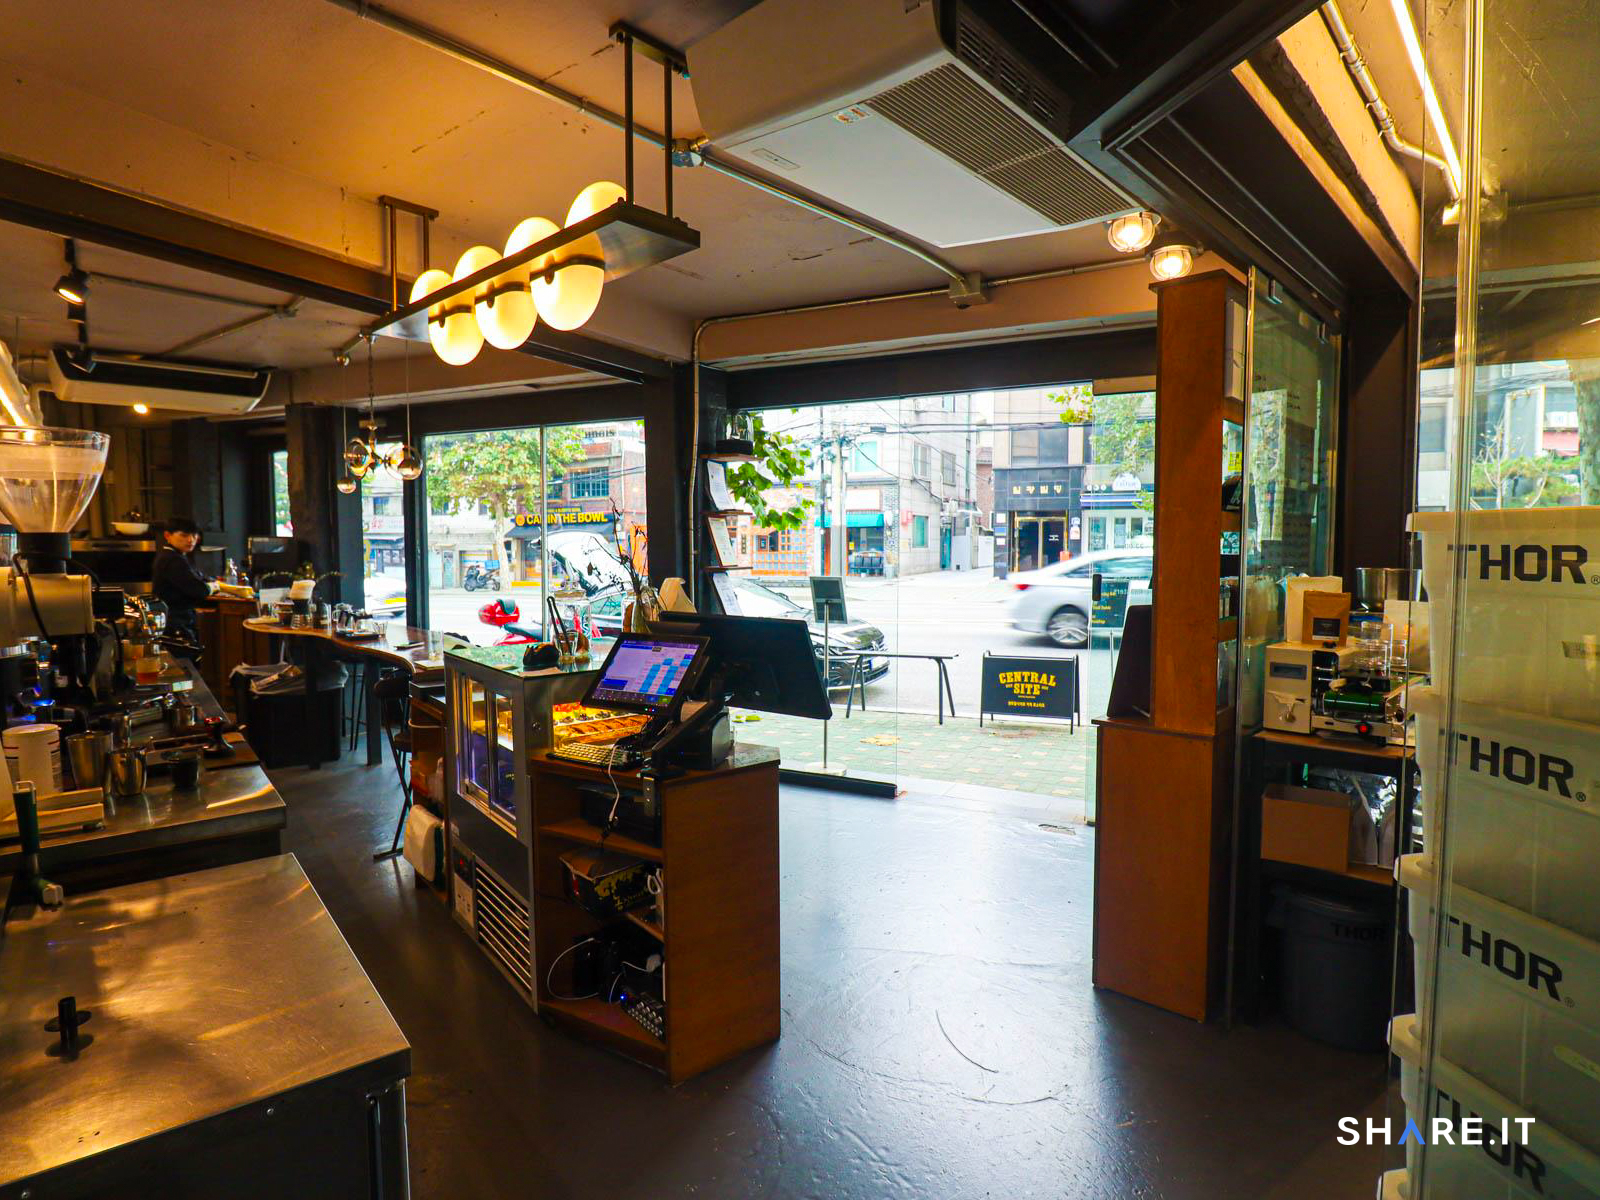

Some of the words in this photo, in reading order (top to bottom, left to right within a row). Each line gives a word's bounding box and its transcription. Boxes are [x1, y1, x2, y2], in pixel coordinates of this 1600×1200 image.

[578, 511, 608, 523] BOWL
[1447, 544, 1588, 584] THOR
[998, 671, 1057, 687] CENTRAL
[1013, 683, 1041, 695] SITE
[1330, 921, 1386, 942] THOR
